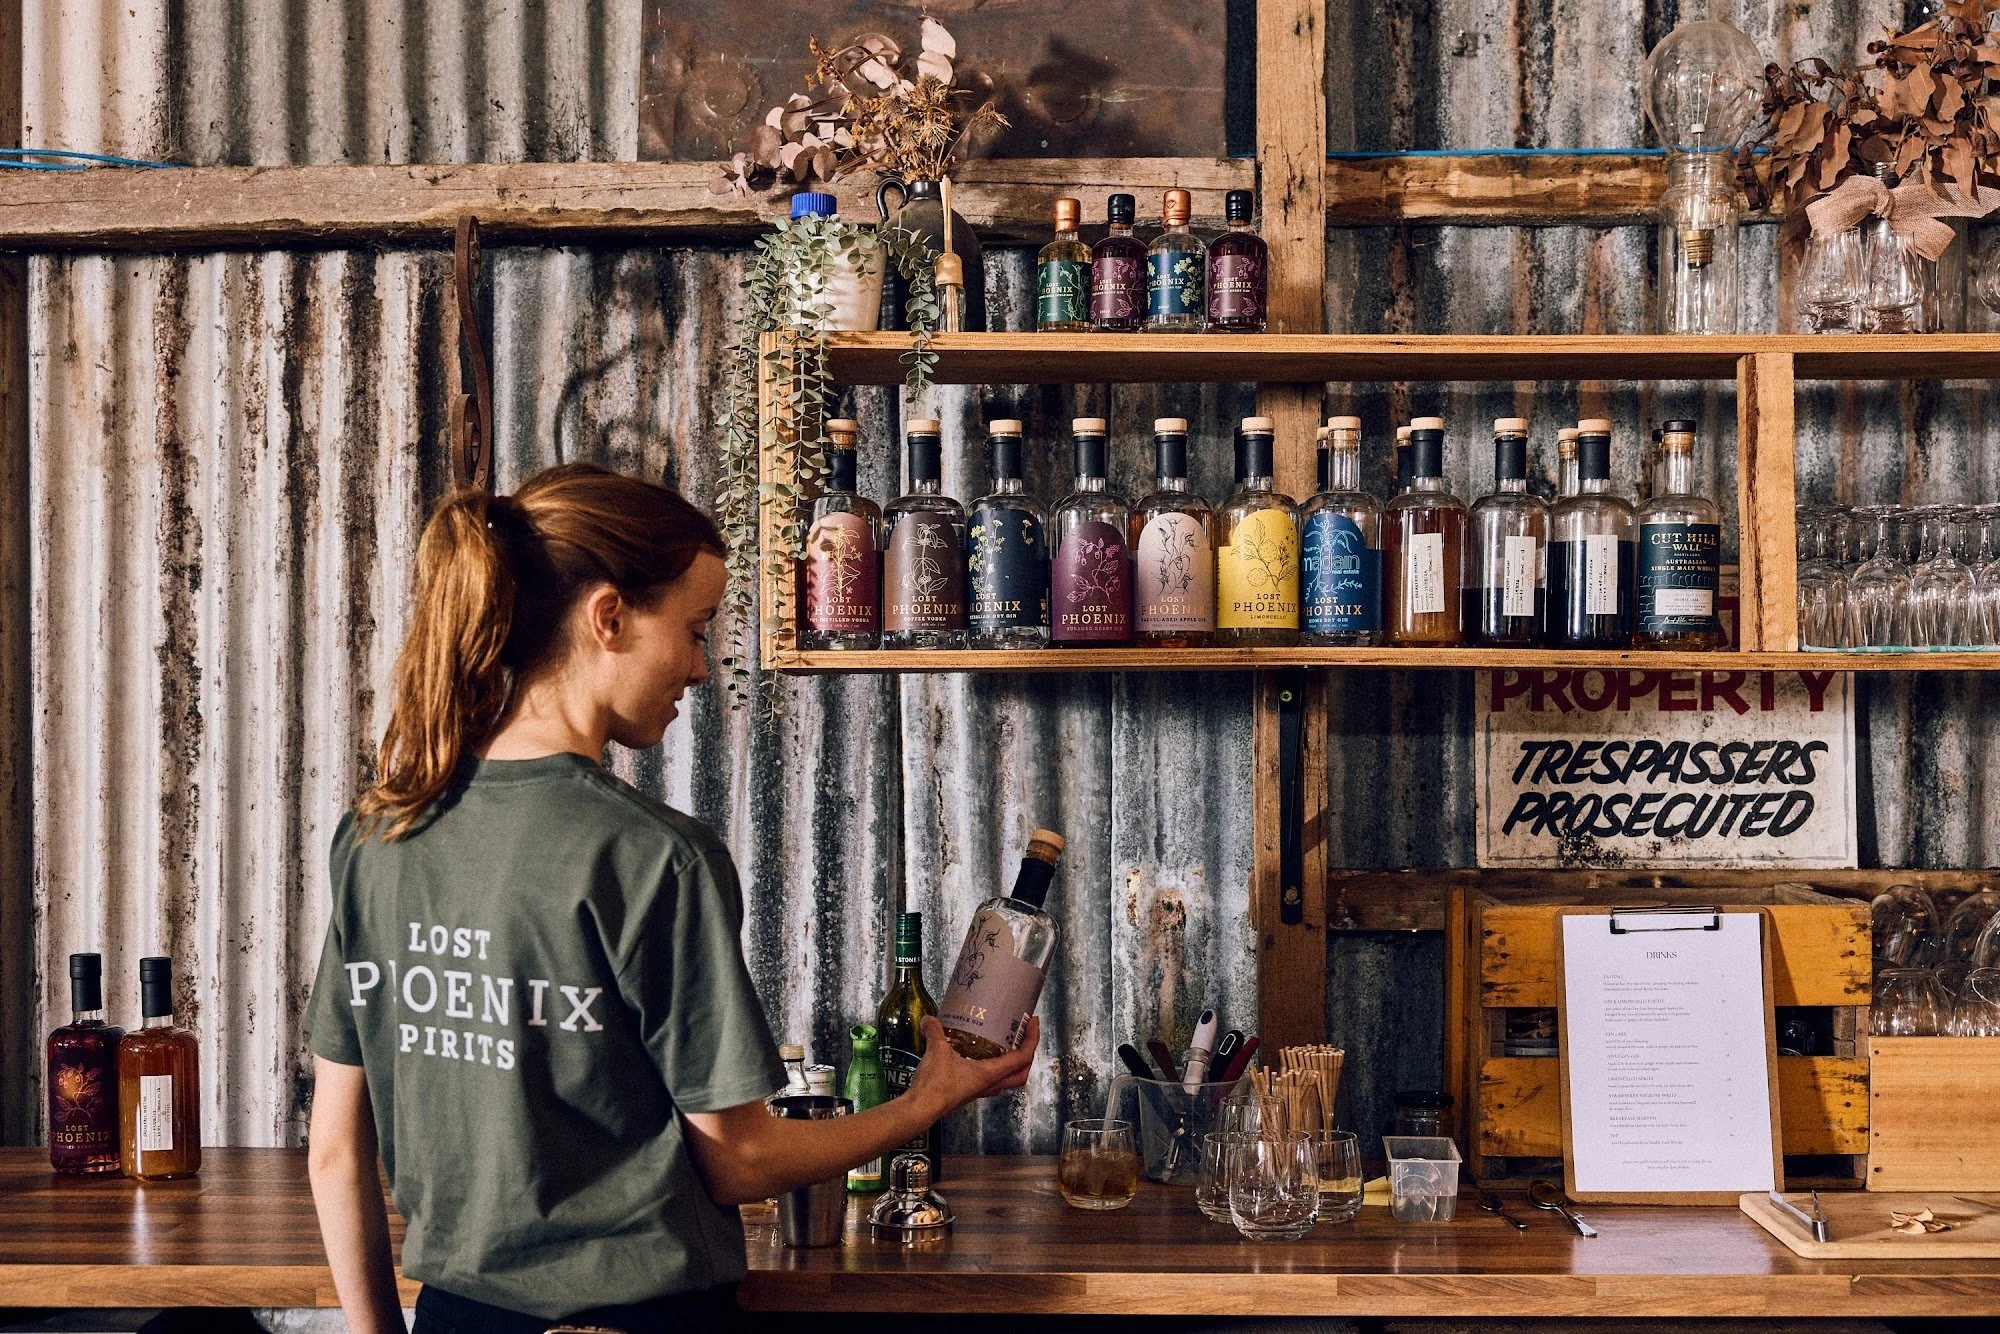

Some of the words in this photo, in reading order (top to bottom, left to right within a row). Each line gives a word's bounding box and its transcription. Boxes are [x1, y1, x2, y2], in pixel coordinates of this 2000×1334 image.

[1651, 533, 1682, 545] CUT
[1686, 533, 1717, 546] HILL
[1672, 543, 1702, 552] WALL
[1315, 596, 1338, 604] LOST
[892, 604, 957, 615] PHOENIX
[1141, 604, 1206, 615] PHOENIX
[1234, 602, 1297, 613] PHOENIX
[1061, 613, 1126, 625] PHOENIX
[1490, 670, 1837, 716] PROPERTY
[1511, 739, 1828, 786] TRESPASSERS
[1501, 790, 1815, 839] PROSECUTED
[408, 922, 491, 960] LOST
[1646, 951, 1678, 959] DRINKS
[952, 1015, 970, 1023] APPLE
[971, 1019, 984, 1027] GIN
[399, 1023, 515, 1070] PIRITS
